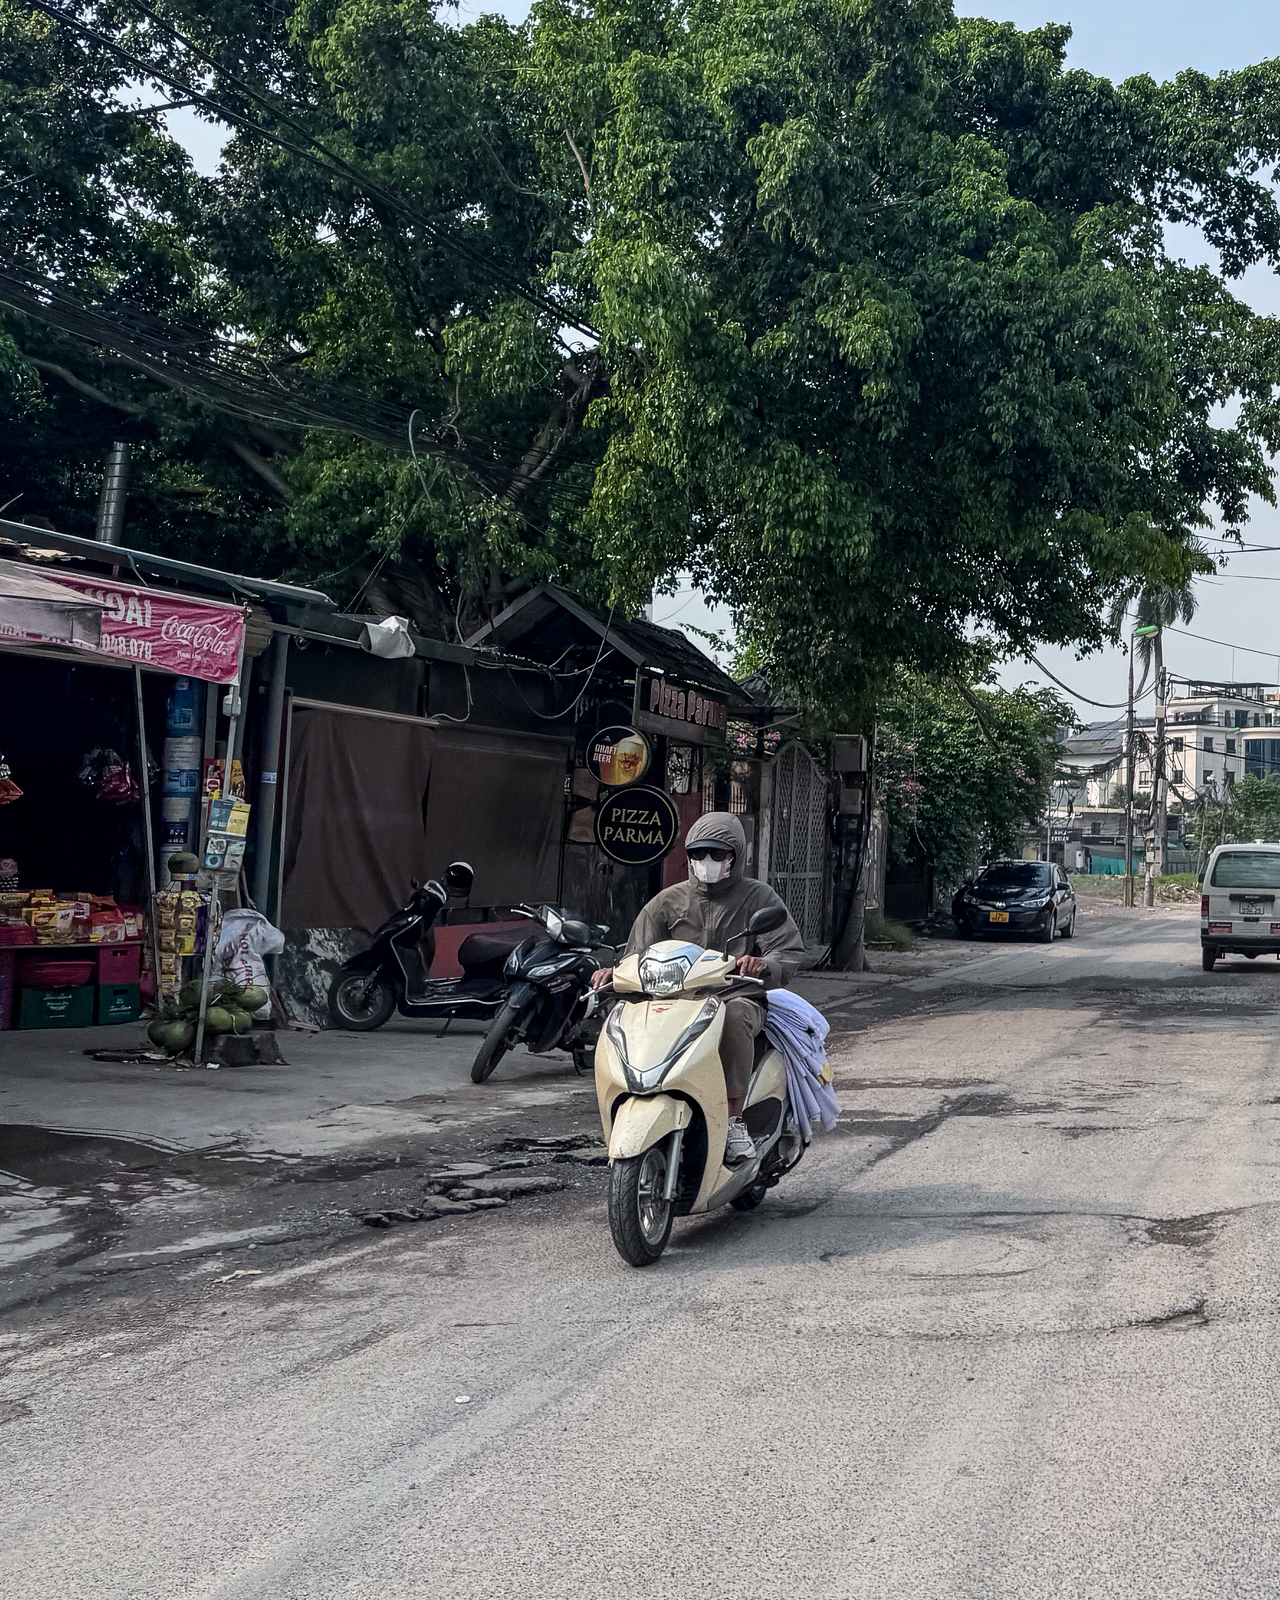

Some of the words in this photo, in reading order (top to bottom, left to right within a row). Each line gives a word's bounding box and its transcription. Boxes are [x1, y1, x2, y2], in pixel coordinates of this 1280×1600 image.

[650, 677, 686, 720] Pizza
[687, 690, 726, 730] Parma
[593, 752, 612, 763] BEER
[595, 744, 618, 755] DRAFT
[611, 808, 661, 825] PIZZA
[604, 827, 664, 845] PARMA
